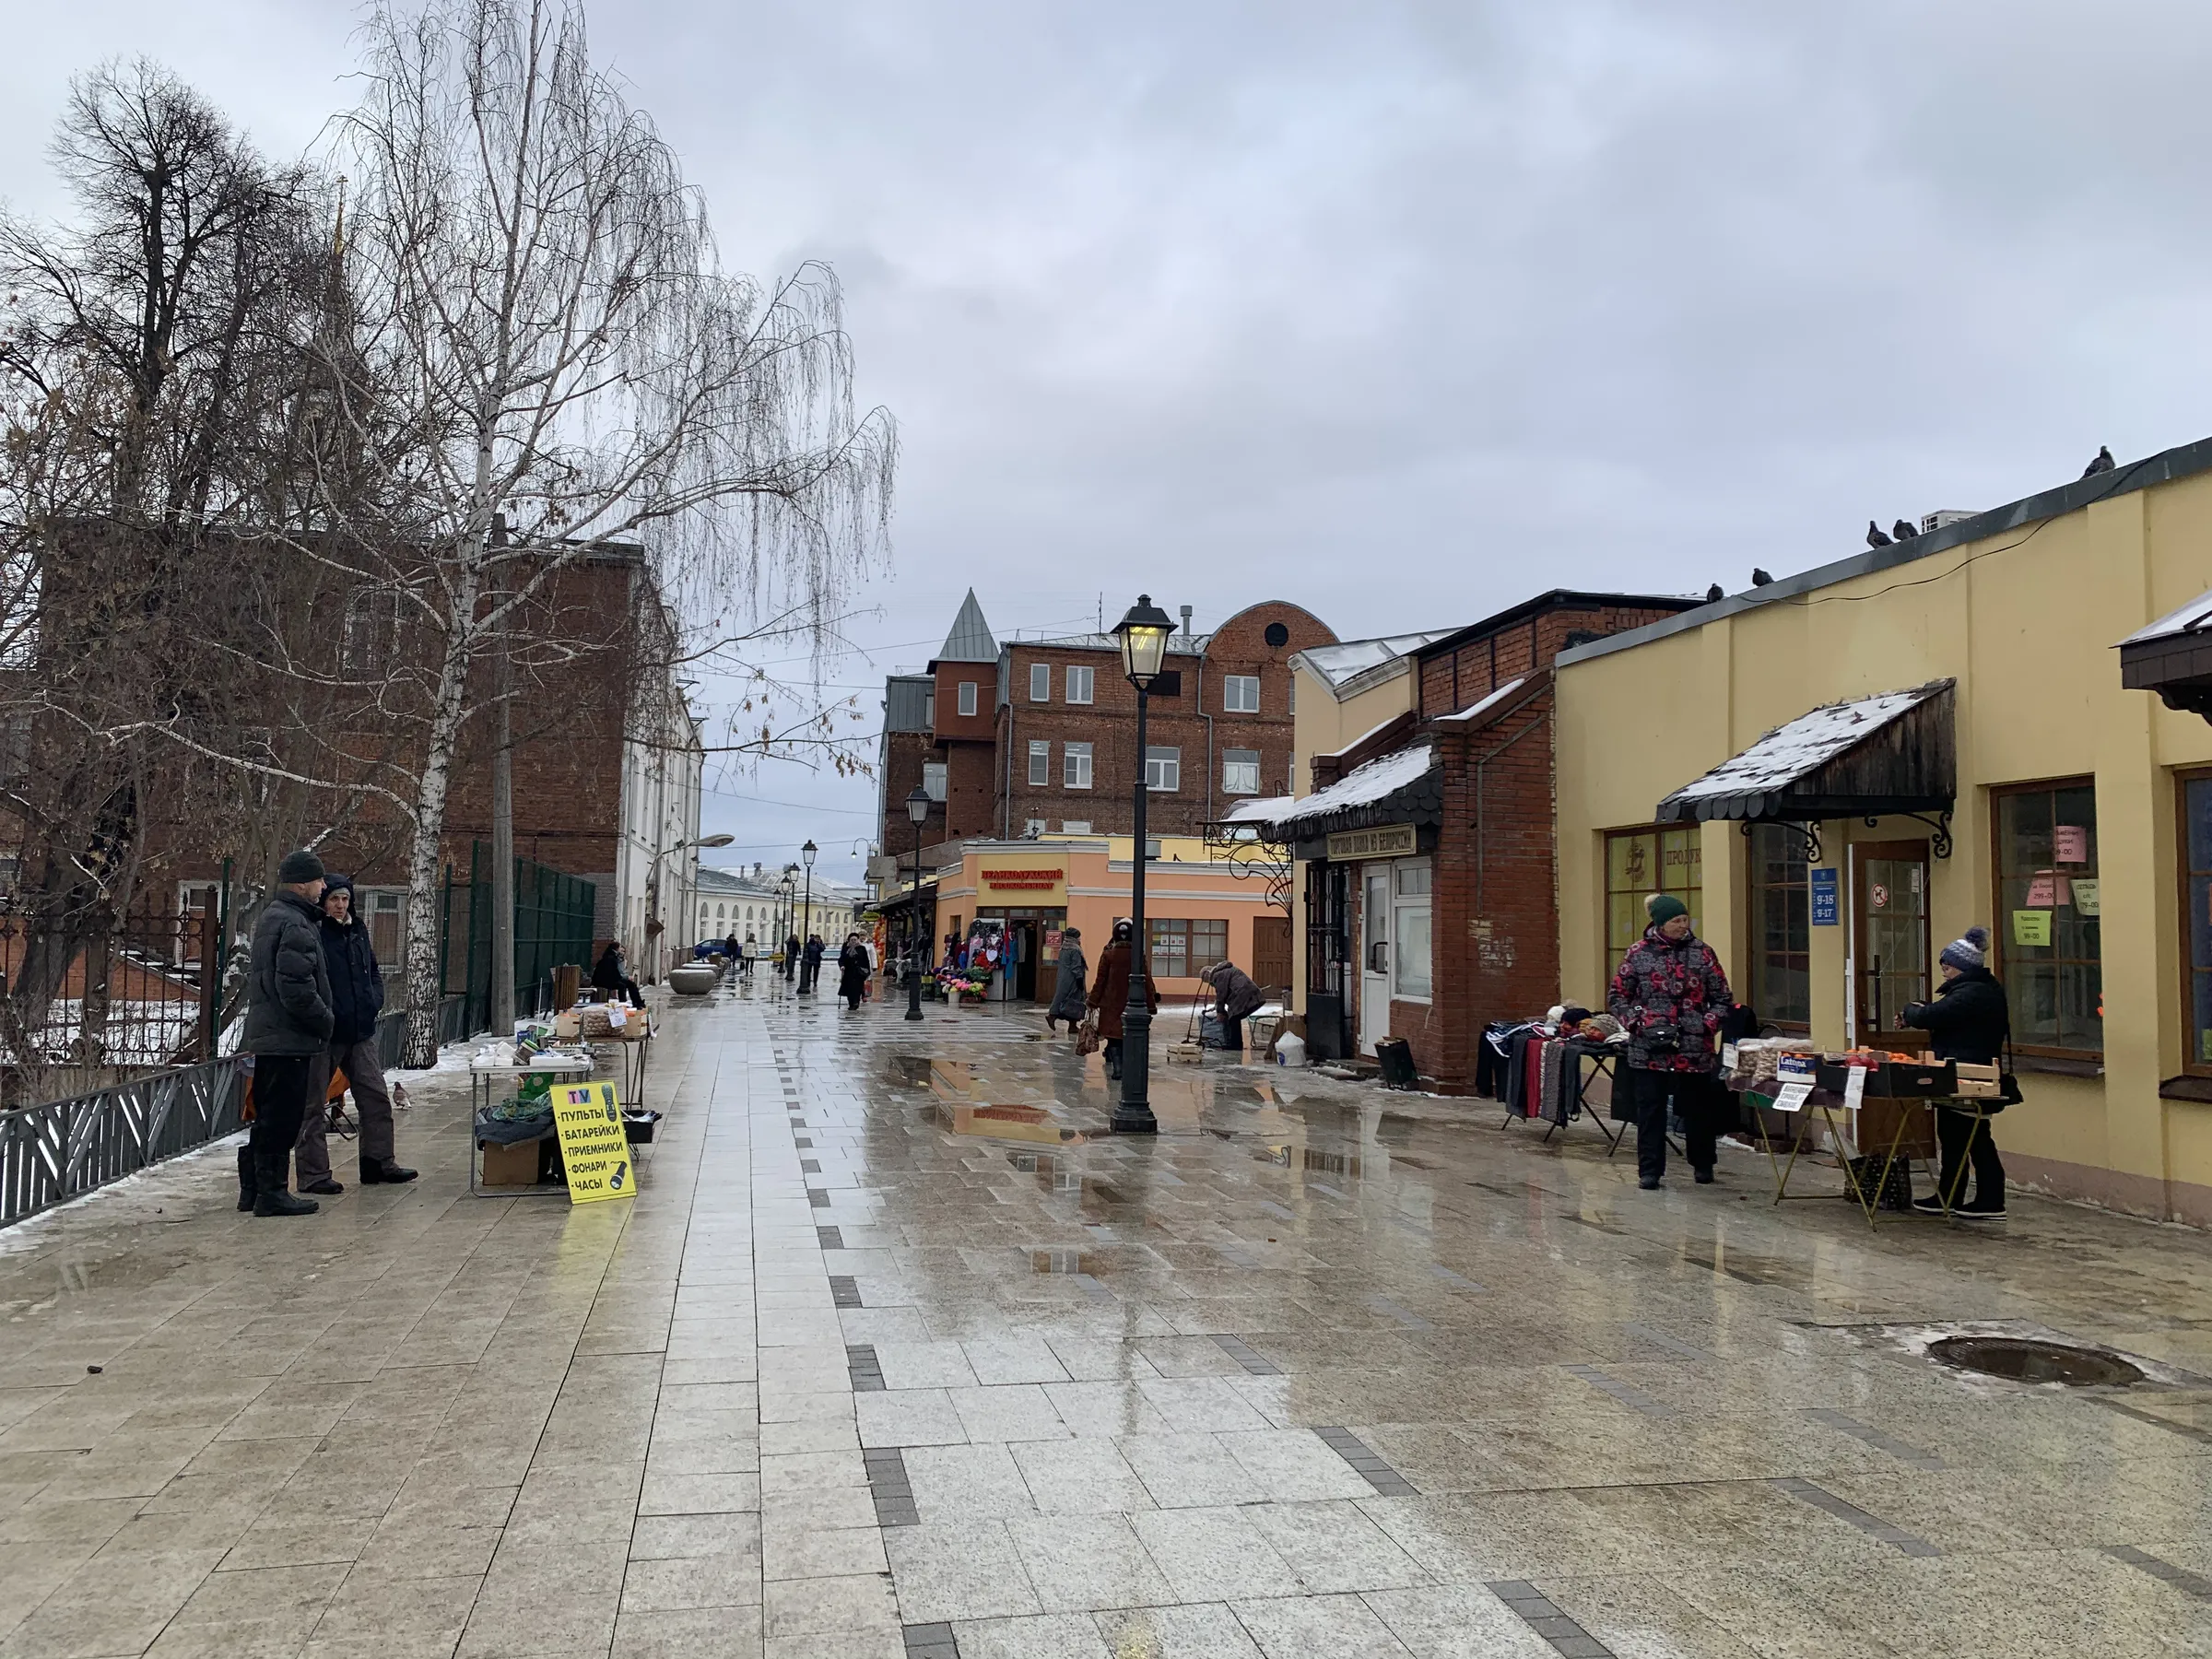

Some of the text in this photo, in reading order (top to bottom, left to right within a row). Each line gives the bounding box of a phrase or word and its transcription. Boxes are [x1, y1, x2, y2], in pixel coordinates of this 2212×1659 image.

[981, 868, 1064, 879] ВЕЛИКОЛУКСКИЙ
[569, 1089, 590, 1103] TV
[560, 1109, 604, 1122] ПУЛЬТЫ
[564, 1124, 620, 1140] БАТАРЕЙКИ
[568, 1141, 624, 1157] ПРИЕМНИКИ
[571, 1160, 607, 1173] ФОНАРИ
[574, 1178, 603, 1191] ЧАСЫ
